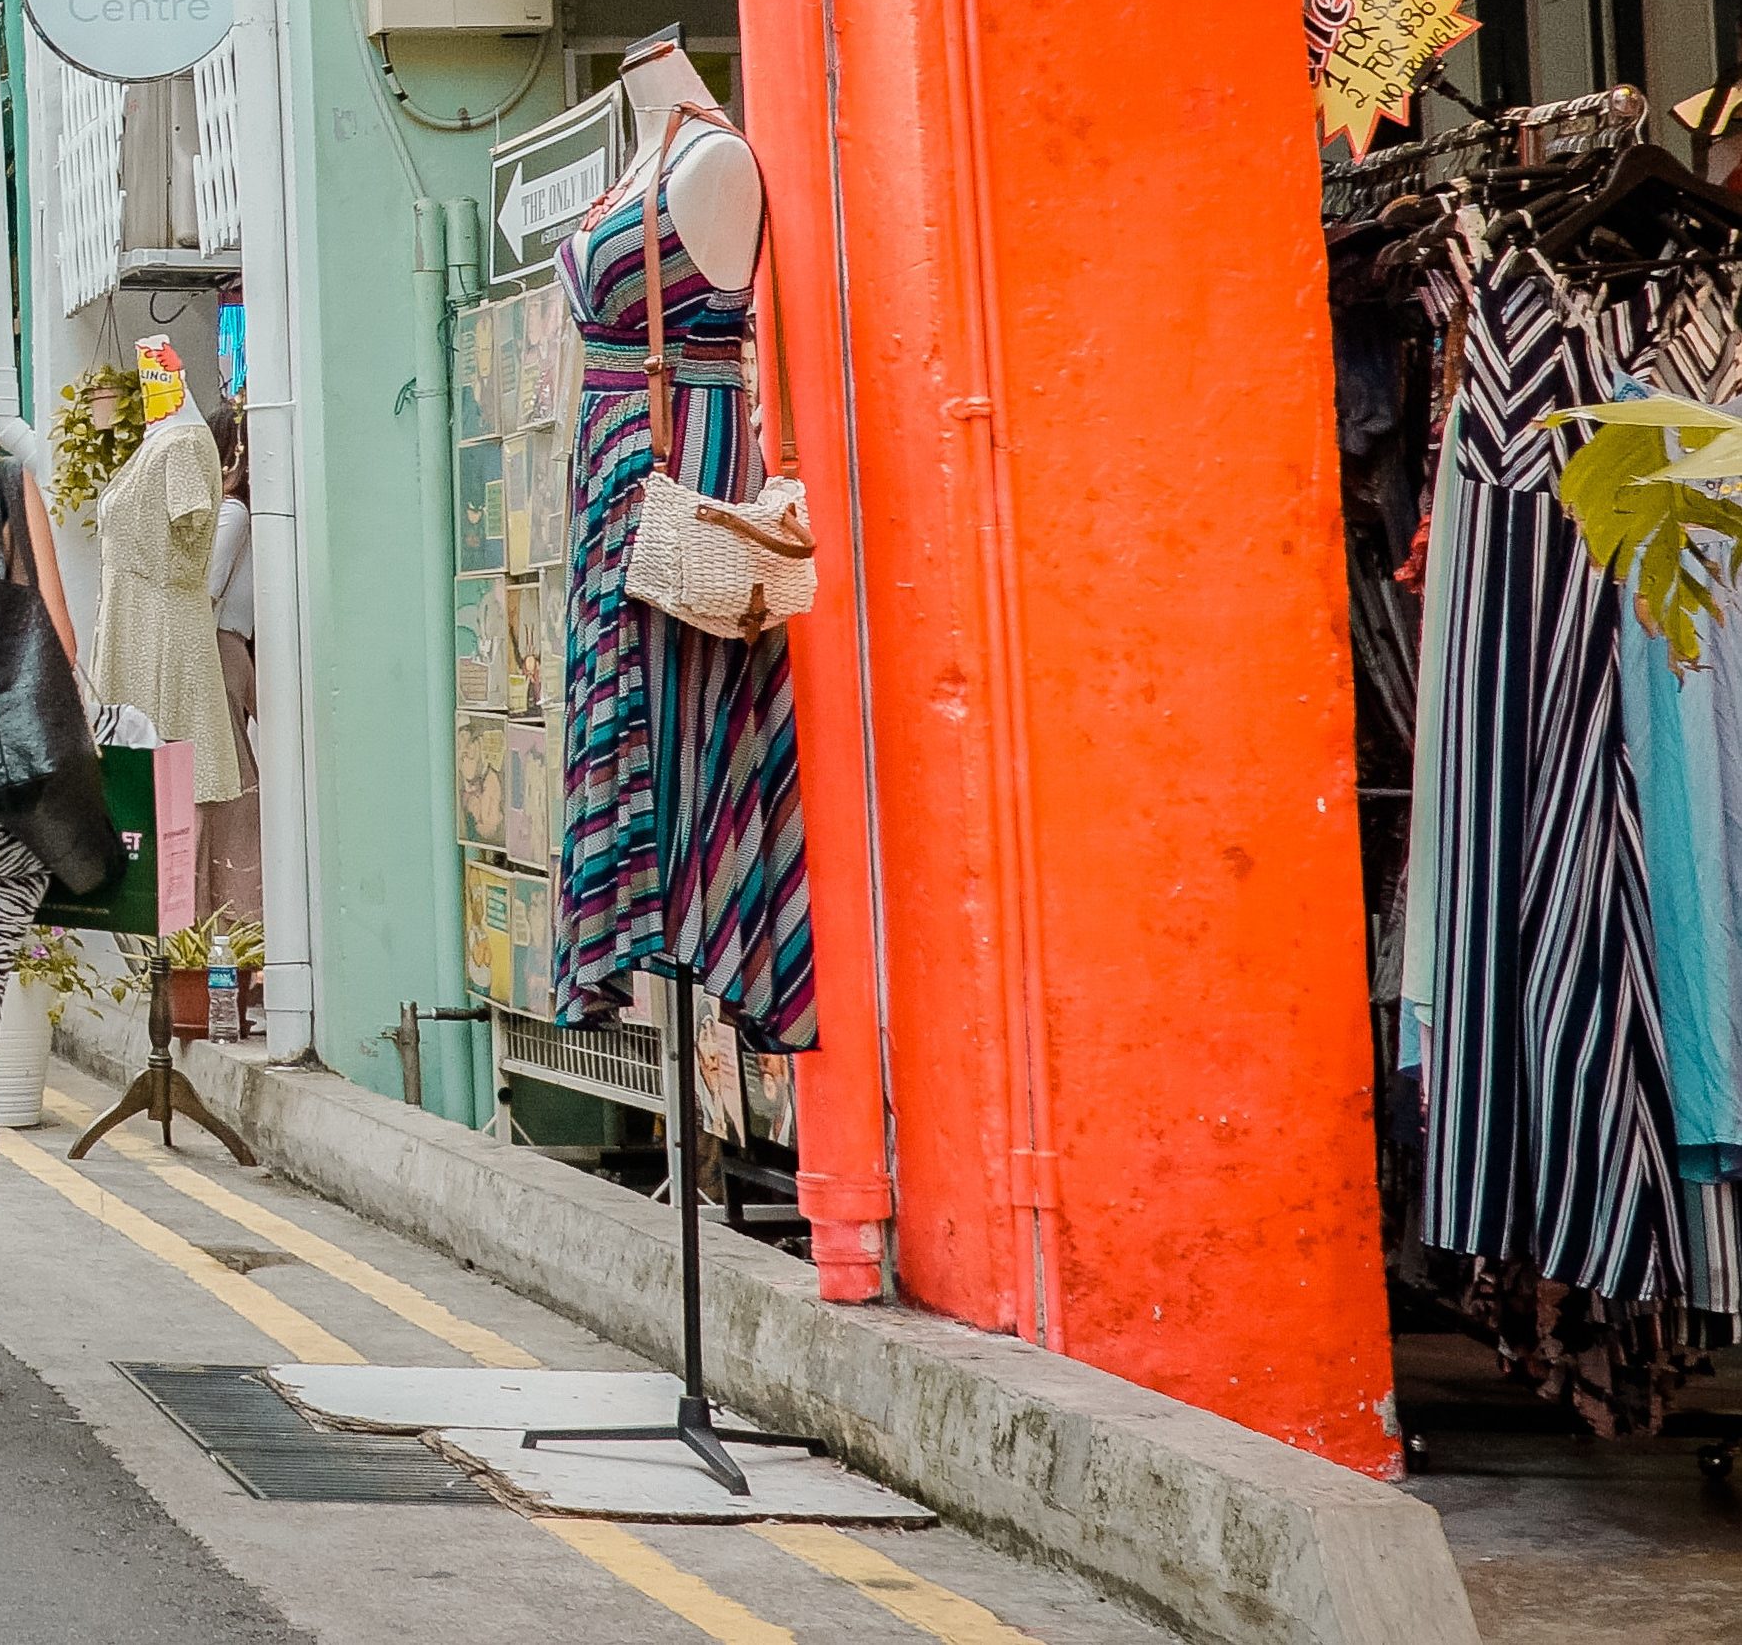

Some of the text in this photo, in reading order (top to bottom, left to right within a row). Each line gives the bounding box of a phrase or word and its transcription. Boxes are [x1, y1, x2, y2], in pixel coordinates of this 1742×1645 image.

[1361, 39, 1410, 81] FOR
[520, 162, 603, 227] THE ONLY WAY
